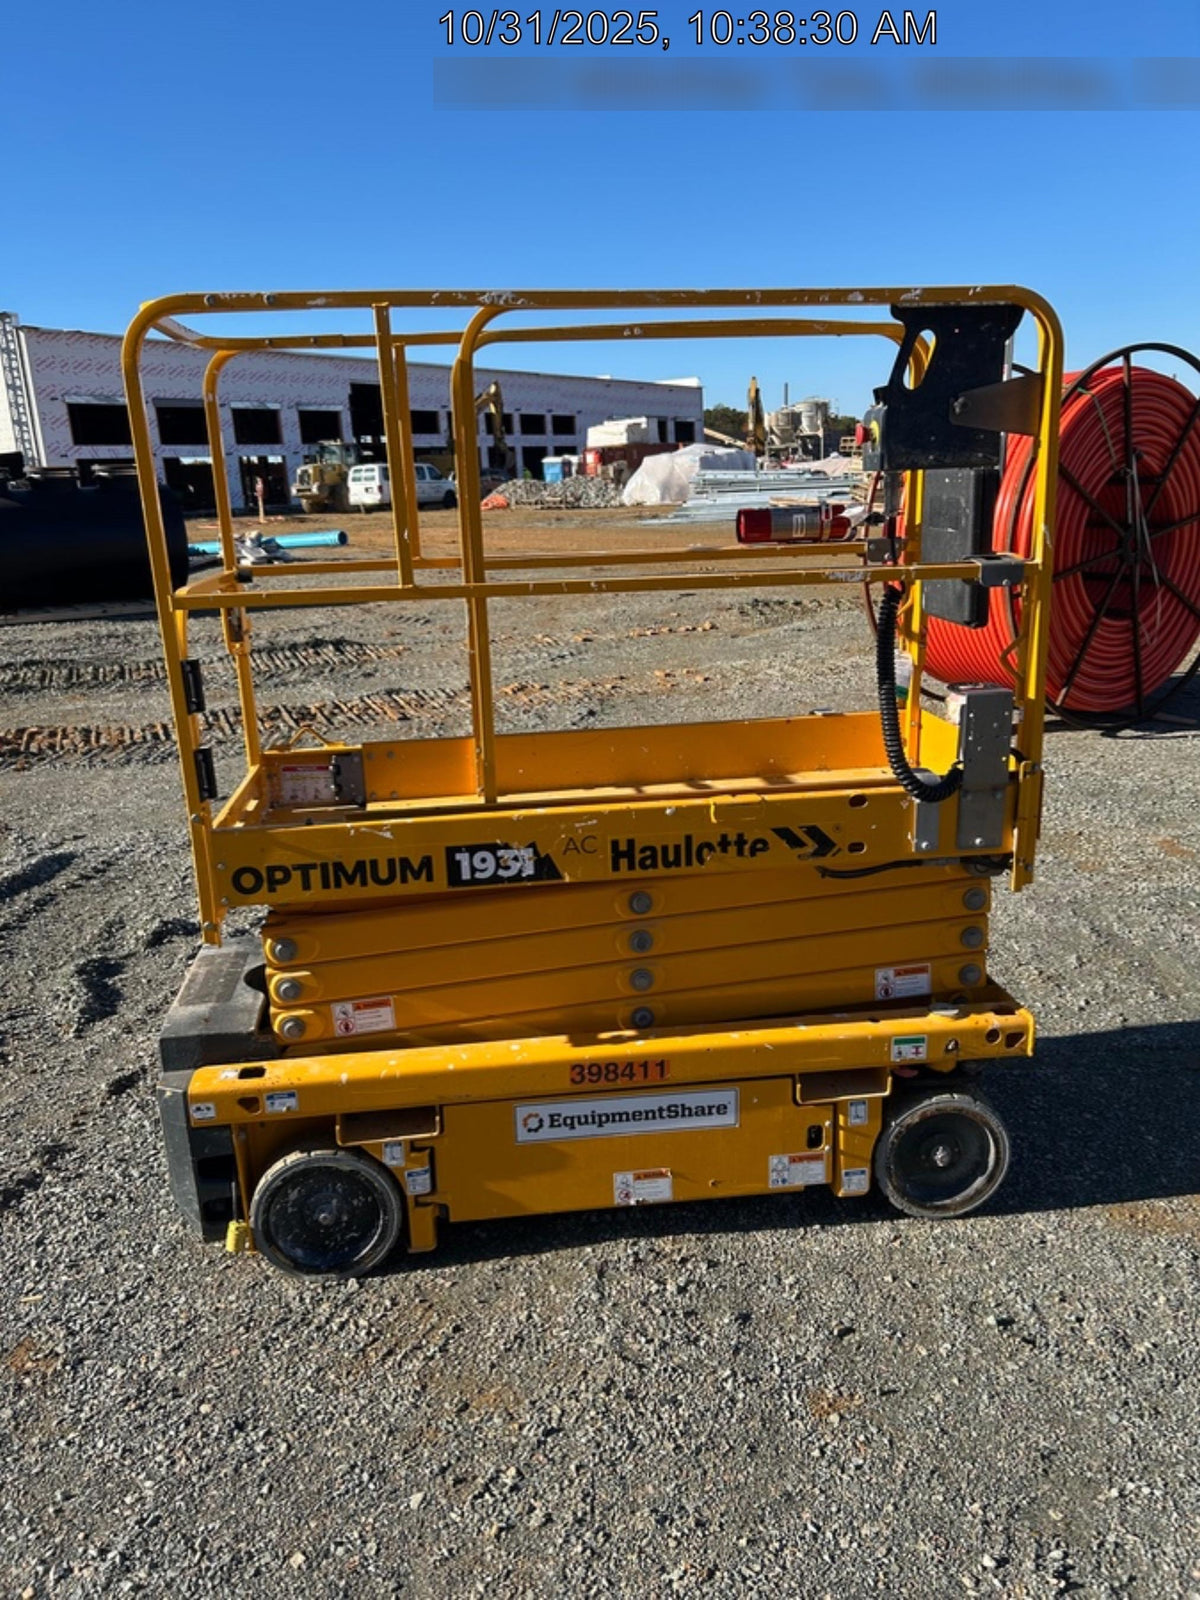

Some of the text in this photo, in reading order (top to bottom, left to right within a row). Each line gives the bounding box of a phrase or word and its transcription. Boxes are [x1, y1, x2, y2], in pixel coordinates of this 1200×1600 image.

[231, 835, 598, 895] OPTIMUM 1931 AC
[610, 832, 770, 872] Haulotte
[570, 1059, 667, 1085] 398411
[548, 1102, 728, 1130] EquipmentShare
